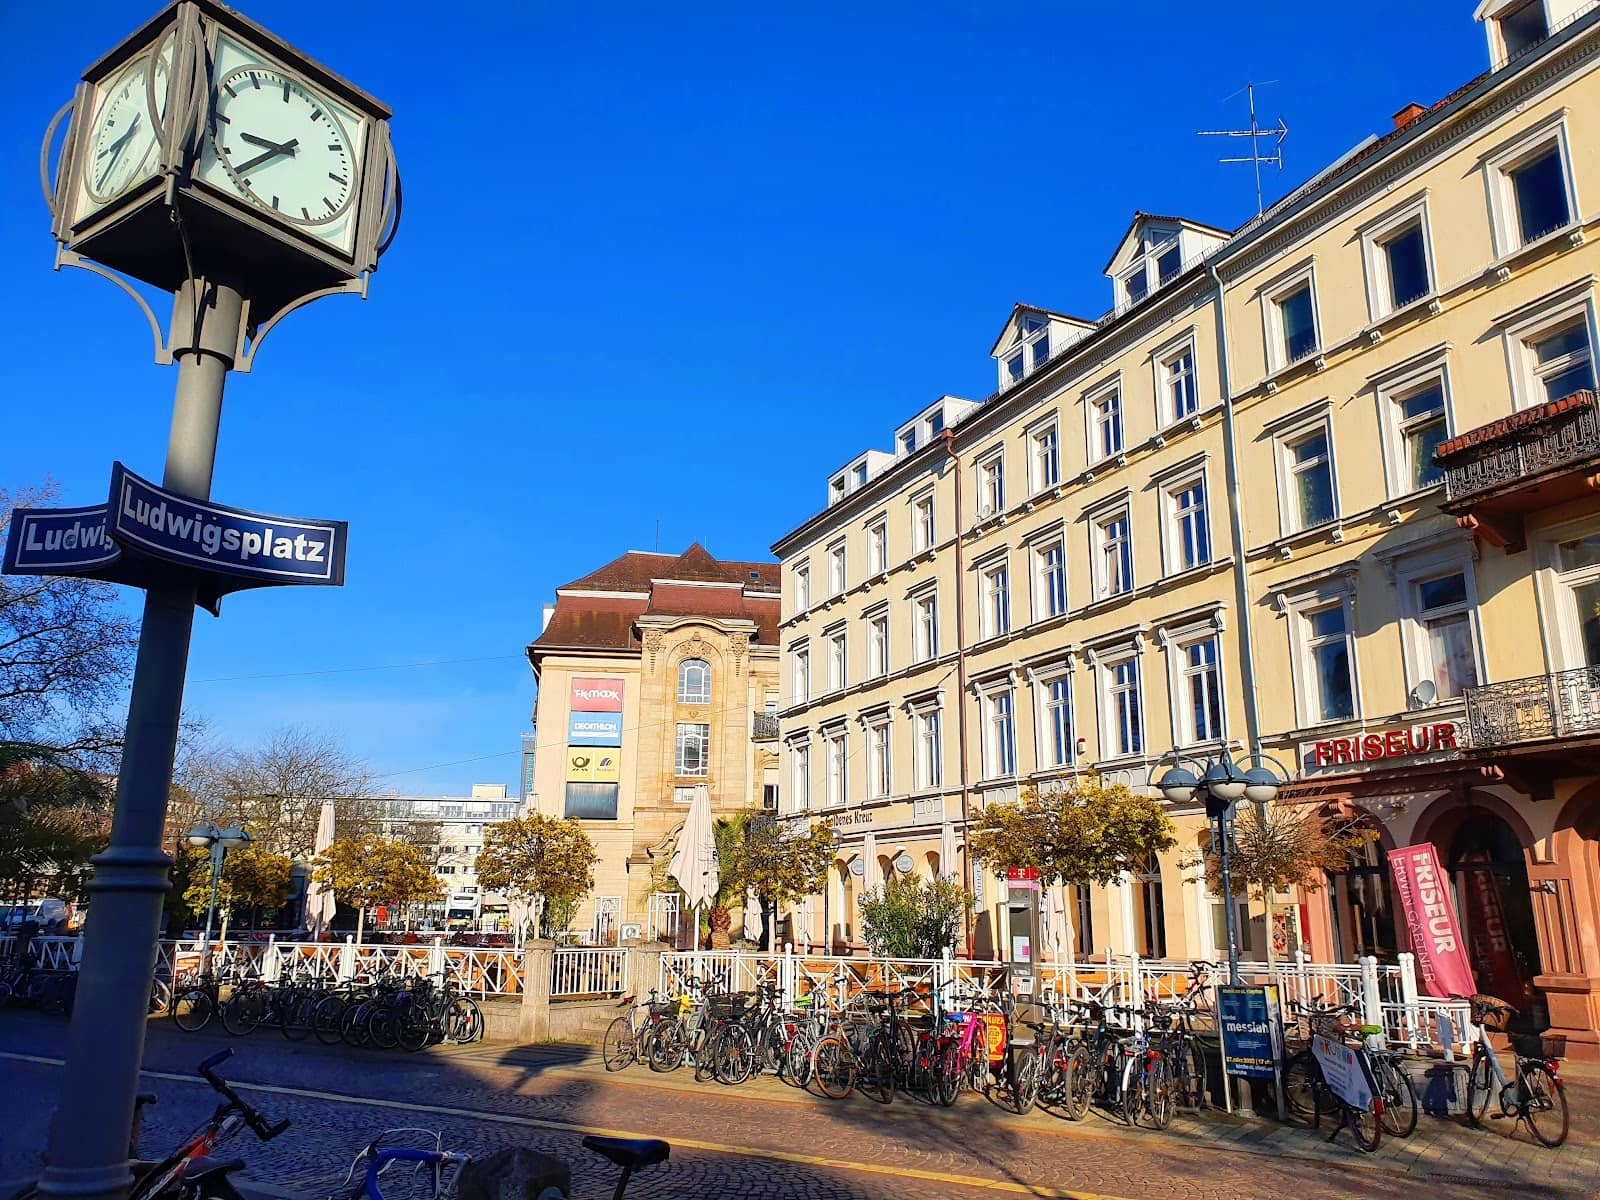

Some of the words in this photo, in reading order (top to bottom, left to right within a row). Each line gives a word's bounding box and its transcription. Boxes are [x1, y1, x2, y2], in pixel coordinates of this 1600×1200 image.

[123, 485, 325, 562] Ludwigsplatz
[1315, 723, 1457, 767] FRISEUR
[1392, 856, 1414, 906] ERWIN
[1406, 909, 1437, 984] GÄRTNER
[1411, 851, 1456, 955] FRISEUR
[1227, 1021, 1269, 1033] messiah
